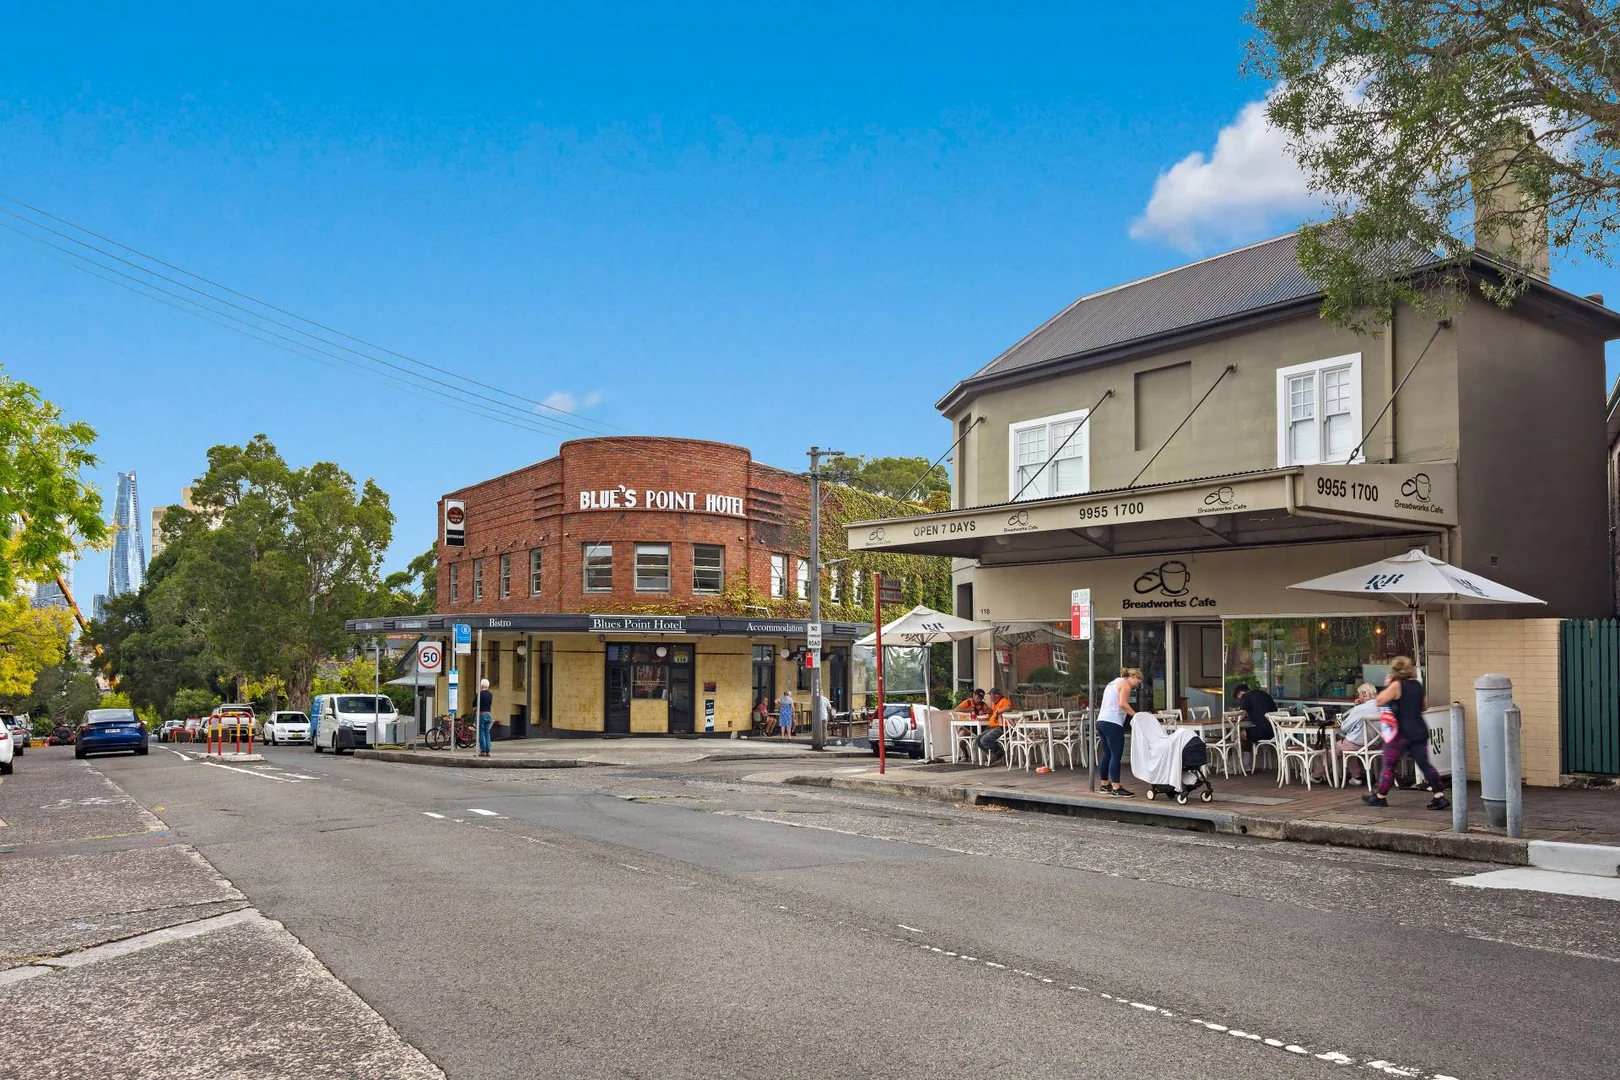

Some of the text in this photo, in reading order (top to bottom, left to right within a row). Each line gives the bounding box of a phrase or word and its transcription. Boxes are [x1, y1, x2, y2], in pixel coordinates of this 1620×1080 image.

[1317, 477, 1379, 502] 9955 1700
[579, 484, 746, 517] BLUE'S POINT HOTEL
[1394, 499, 1444, 514] Breadworks Cafe
[1079, 502, 1144, 520] 9955 1700
[1197, 503, 1247, 514] Breadworks Cafe
[913, 520, 976, 537] OPEN 7 DAYS
[1122, 597, 1217, 609] Breadworks Cafe
[489, 618, 512, 628] Bistro
[593, 618, 682, 630] Blues Point Hotel
[746, 622, 804, 633] Accommodation
[423, 652, 438, 663] 50
